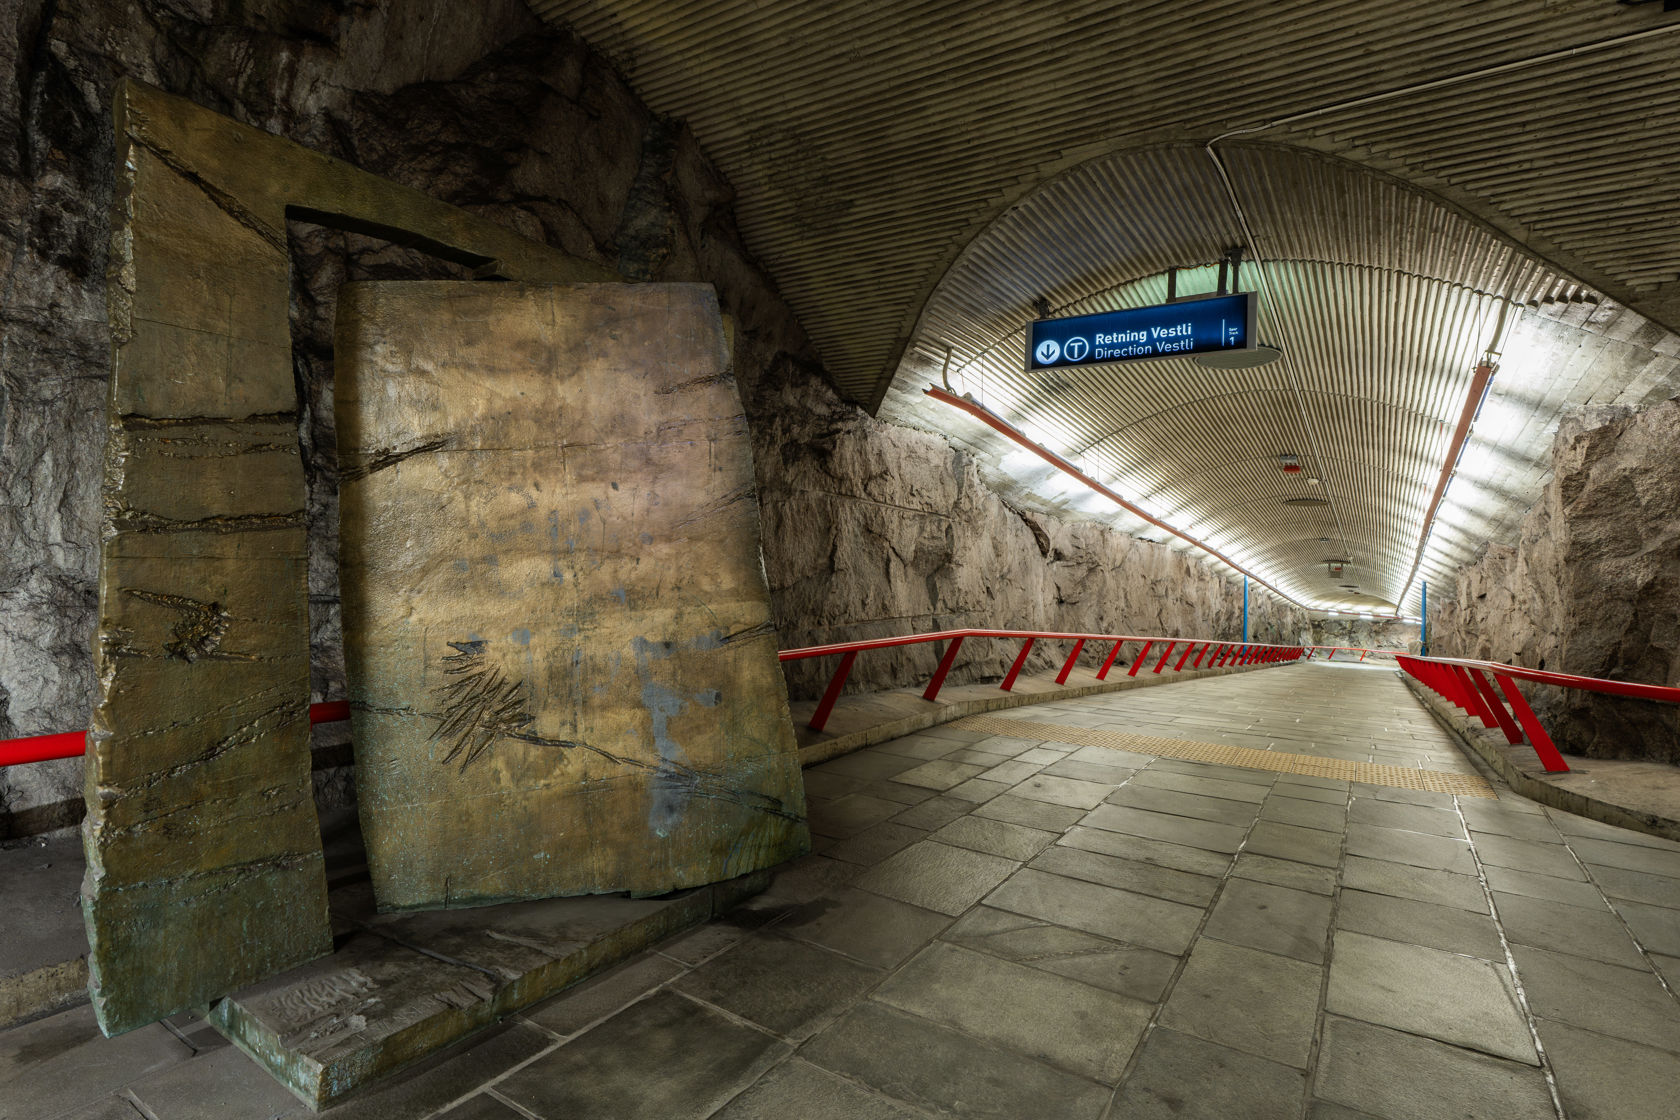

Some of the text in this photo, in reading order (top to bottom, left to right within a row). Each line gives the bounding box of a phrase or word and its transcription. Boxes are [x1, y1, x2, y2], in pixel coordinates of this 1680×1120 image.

[1095, 323, 1192, 345] Retning Vestli
[1229, 336, 1235, 346] 1
[1070, 341, 1083, 359] T
[1095, 338, 1194, 360] Direction Vestli
